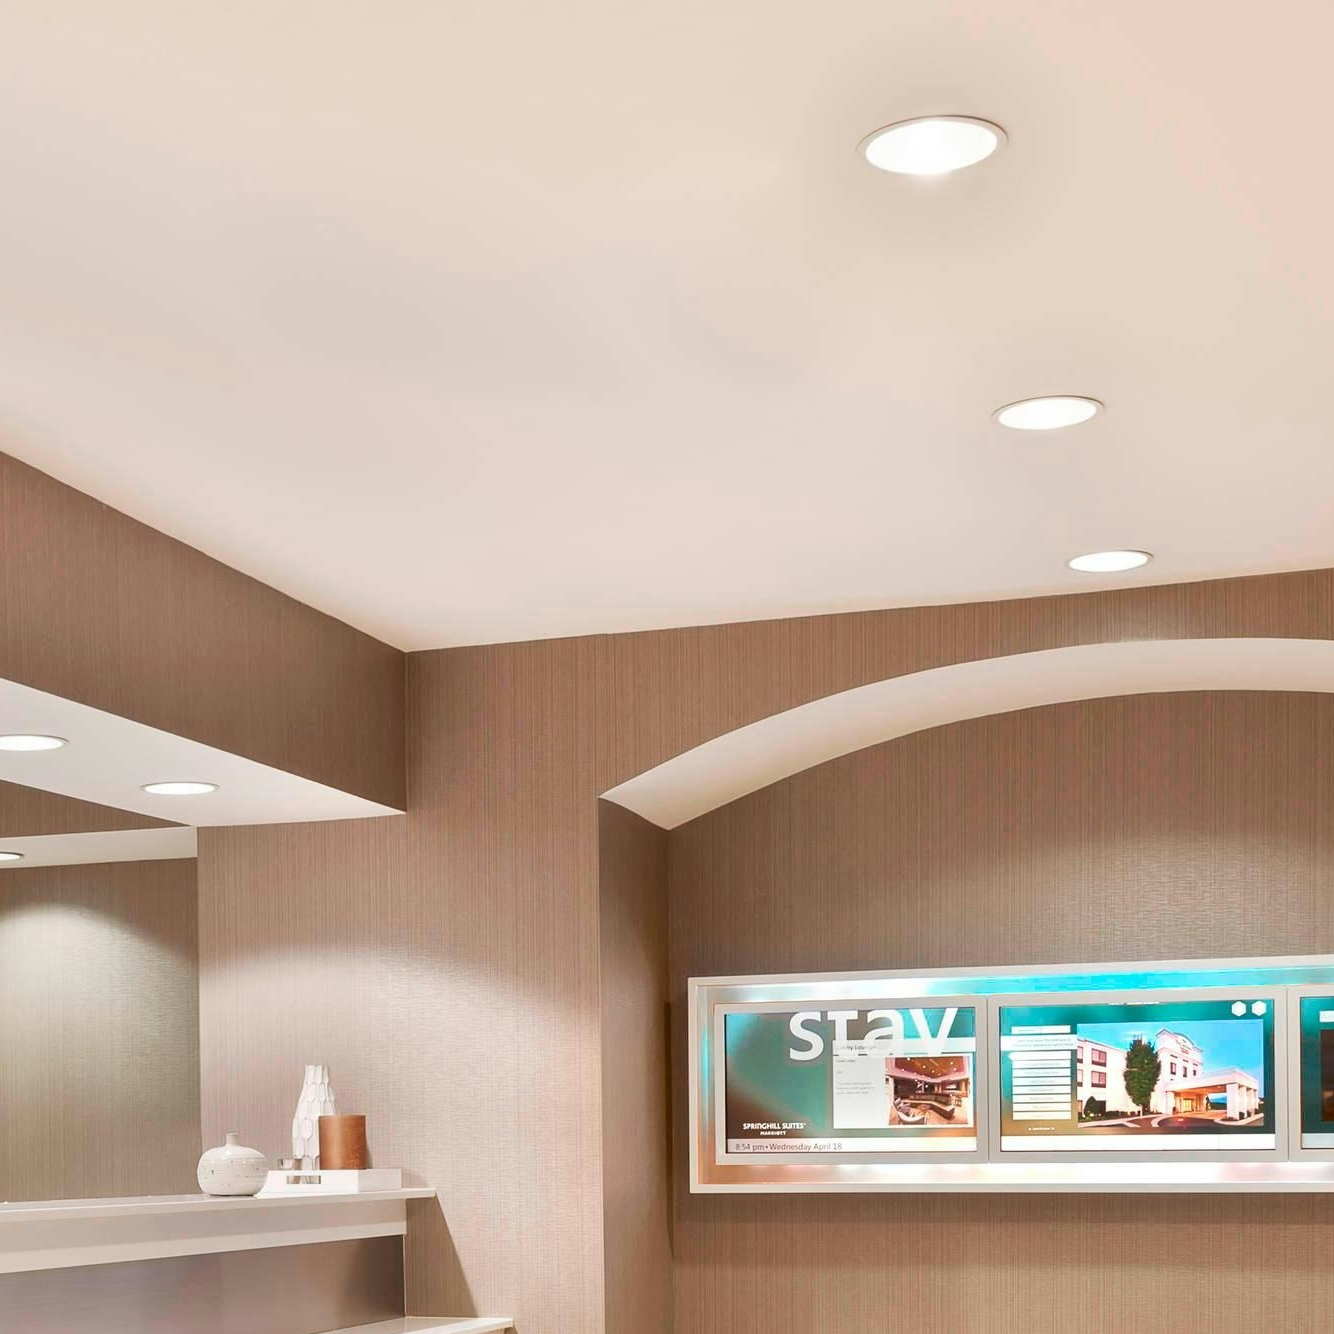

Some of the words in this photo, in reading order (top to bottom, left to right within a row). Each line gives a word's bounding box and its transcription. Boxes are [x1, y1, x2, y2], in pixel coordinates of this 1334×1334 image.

[788, 1008, 958, 1060] stay
[743, 1122, 781, 1130] SPRINGHILL
[735, 1143, 750, 1151] 8:54
[770, 1143, 811, 1152] Wednesday
[813, 1143, 830, 1152] April
